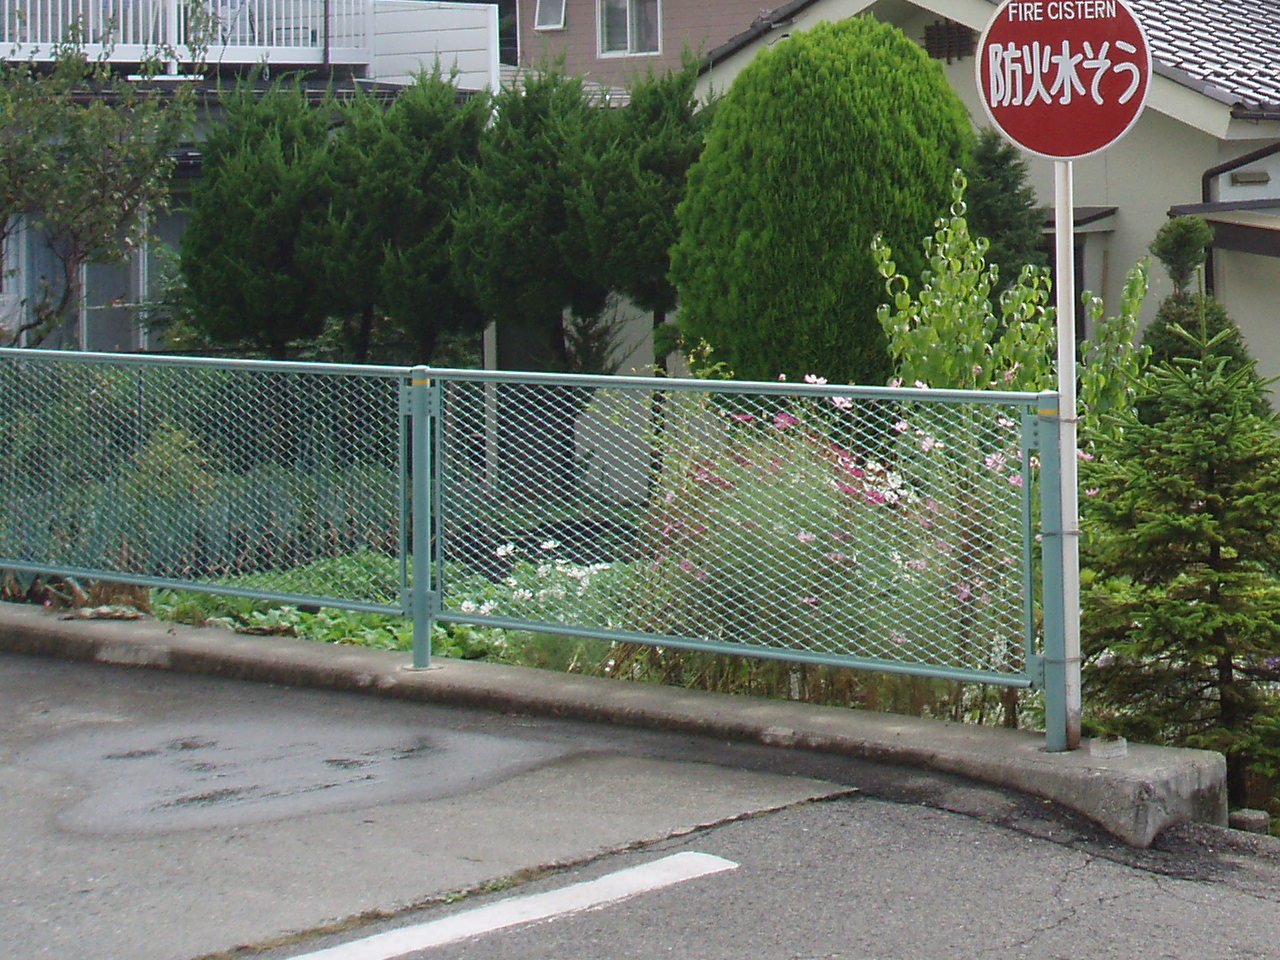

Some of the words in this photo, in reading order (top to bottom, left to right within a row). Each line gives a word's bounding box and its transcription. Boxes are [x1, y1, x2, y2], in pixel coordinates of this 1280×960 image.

[1008, 2, 1044, 22] FIRE
[1047, 0, 1117, 20] CISTERN
[988, 40, 1141, 108] 防火水そう
